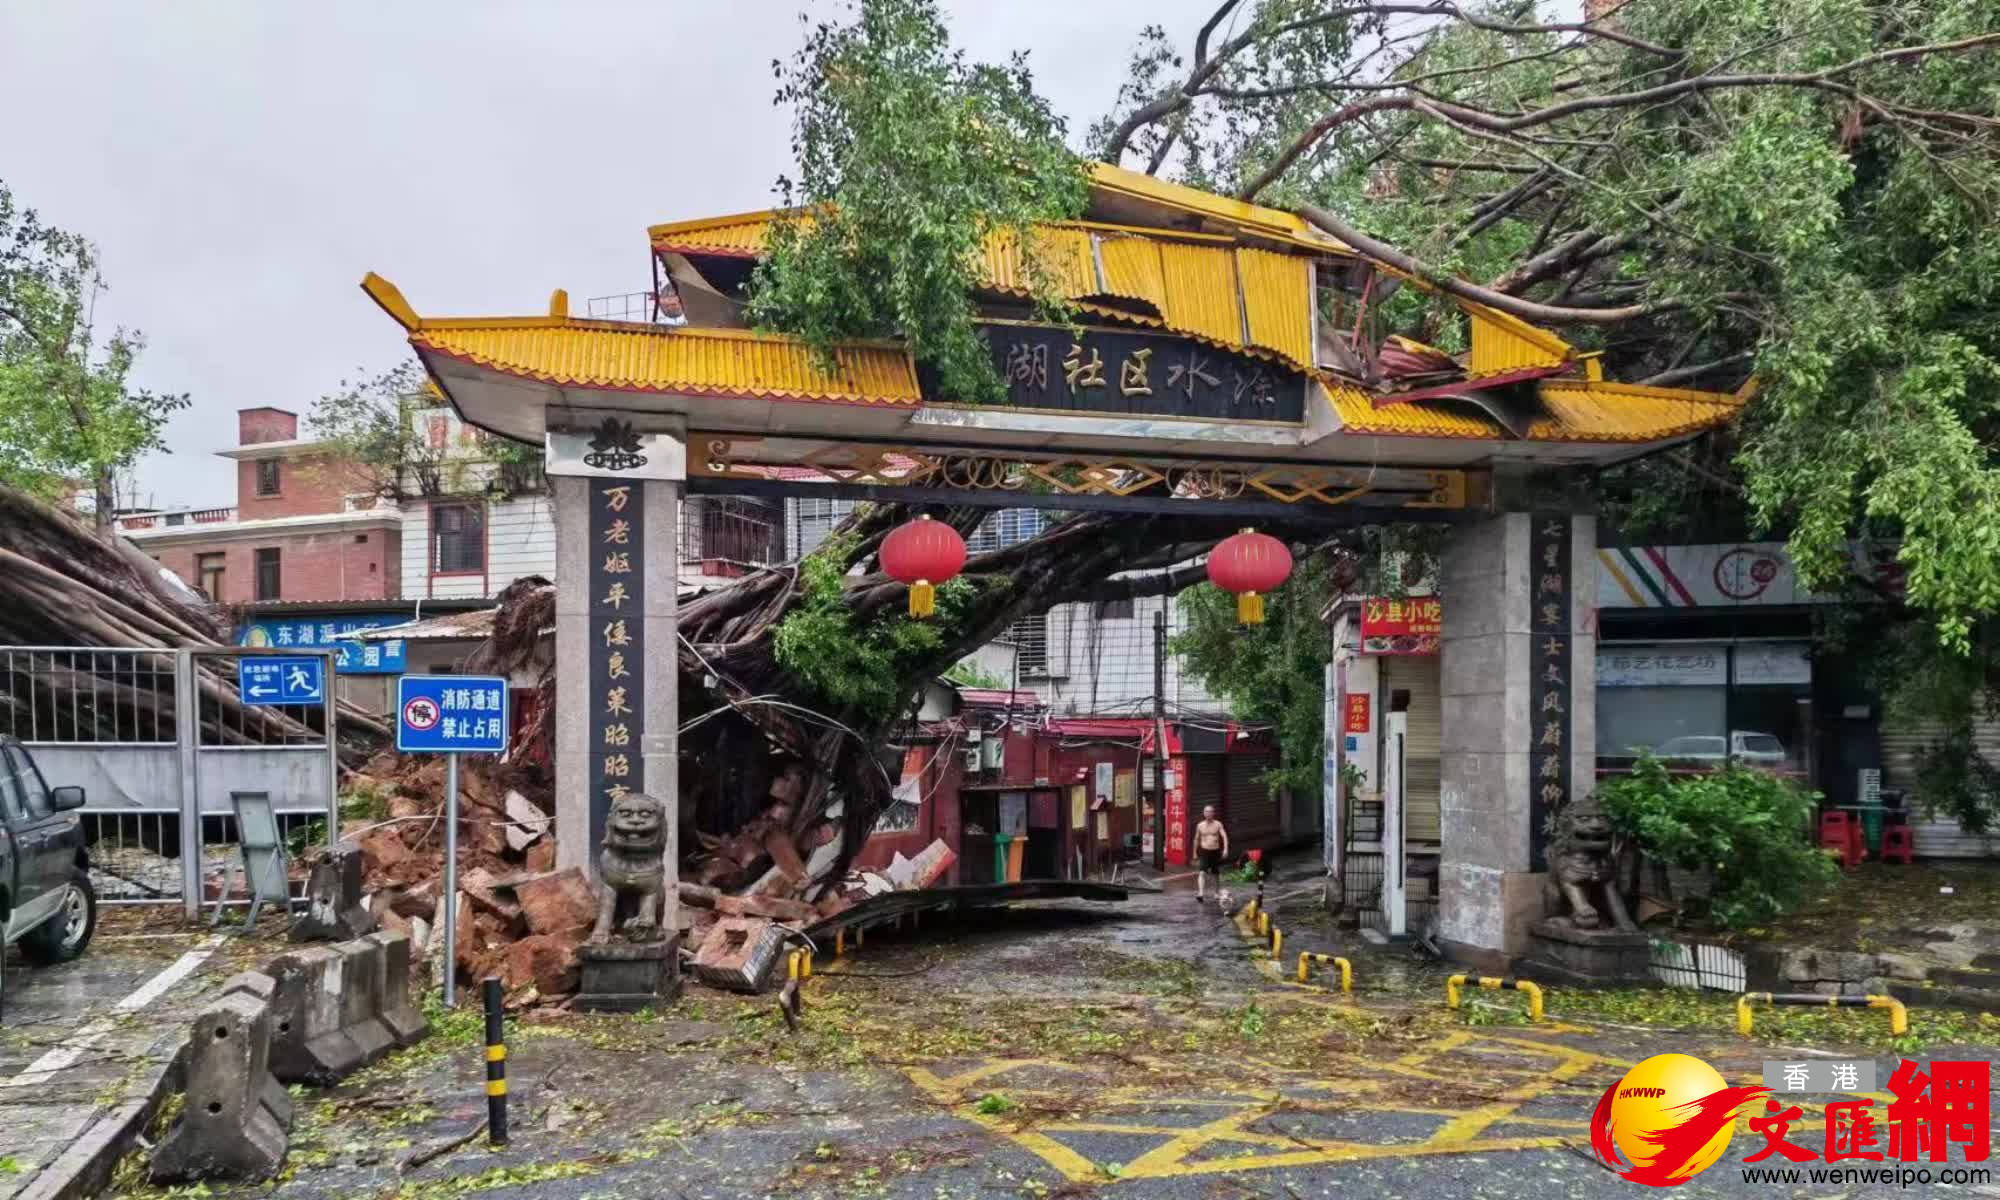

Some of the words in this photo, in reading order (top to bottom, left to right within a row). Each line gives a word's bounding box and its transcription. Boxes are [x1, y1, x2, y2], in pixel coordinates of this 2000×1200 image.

[1367, 601, 1440, 624] 沙县小吃
[277, 623, 379, 646] 东湖派出
[441, 688, 501, 711] 消防通道
[441, 717, 501, 739] 禁止占用
